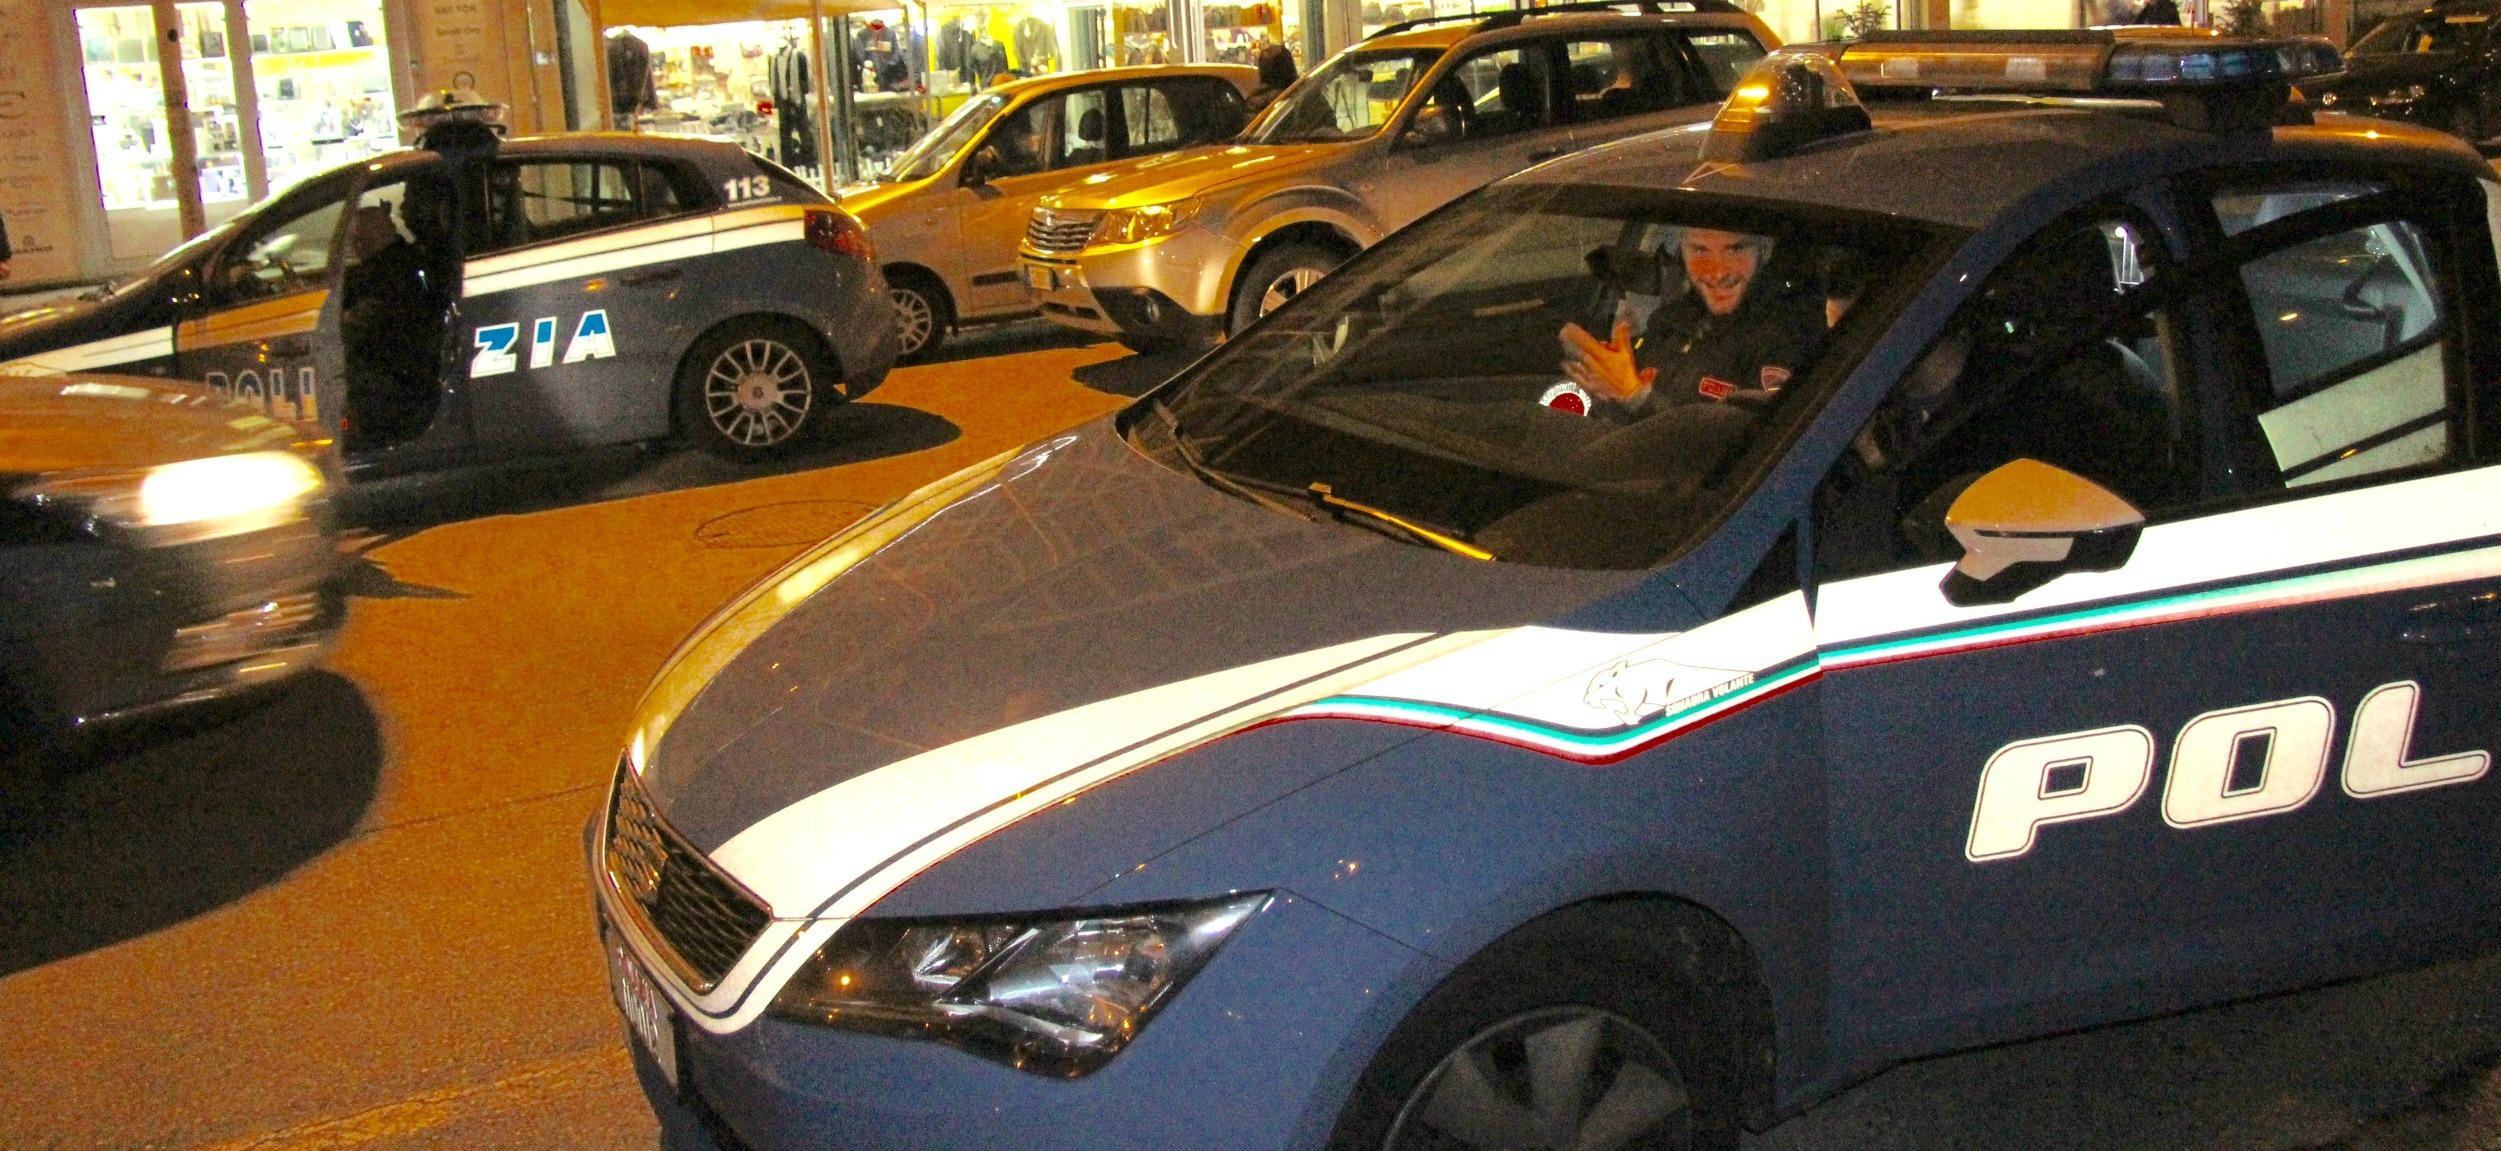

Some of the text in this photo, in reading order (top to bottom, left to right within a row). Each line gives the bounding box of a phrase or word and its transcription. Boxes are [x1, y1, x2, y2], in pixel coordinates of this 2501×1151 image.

[723, 175, 771, 202] 113
[470, 309, 616, 379] ZIA
[1965, 680, 2491, 862] POL
